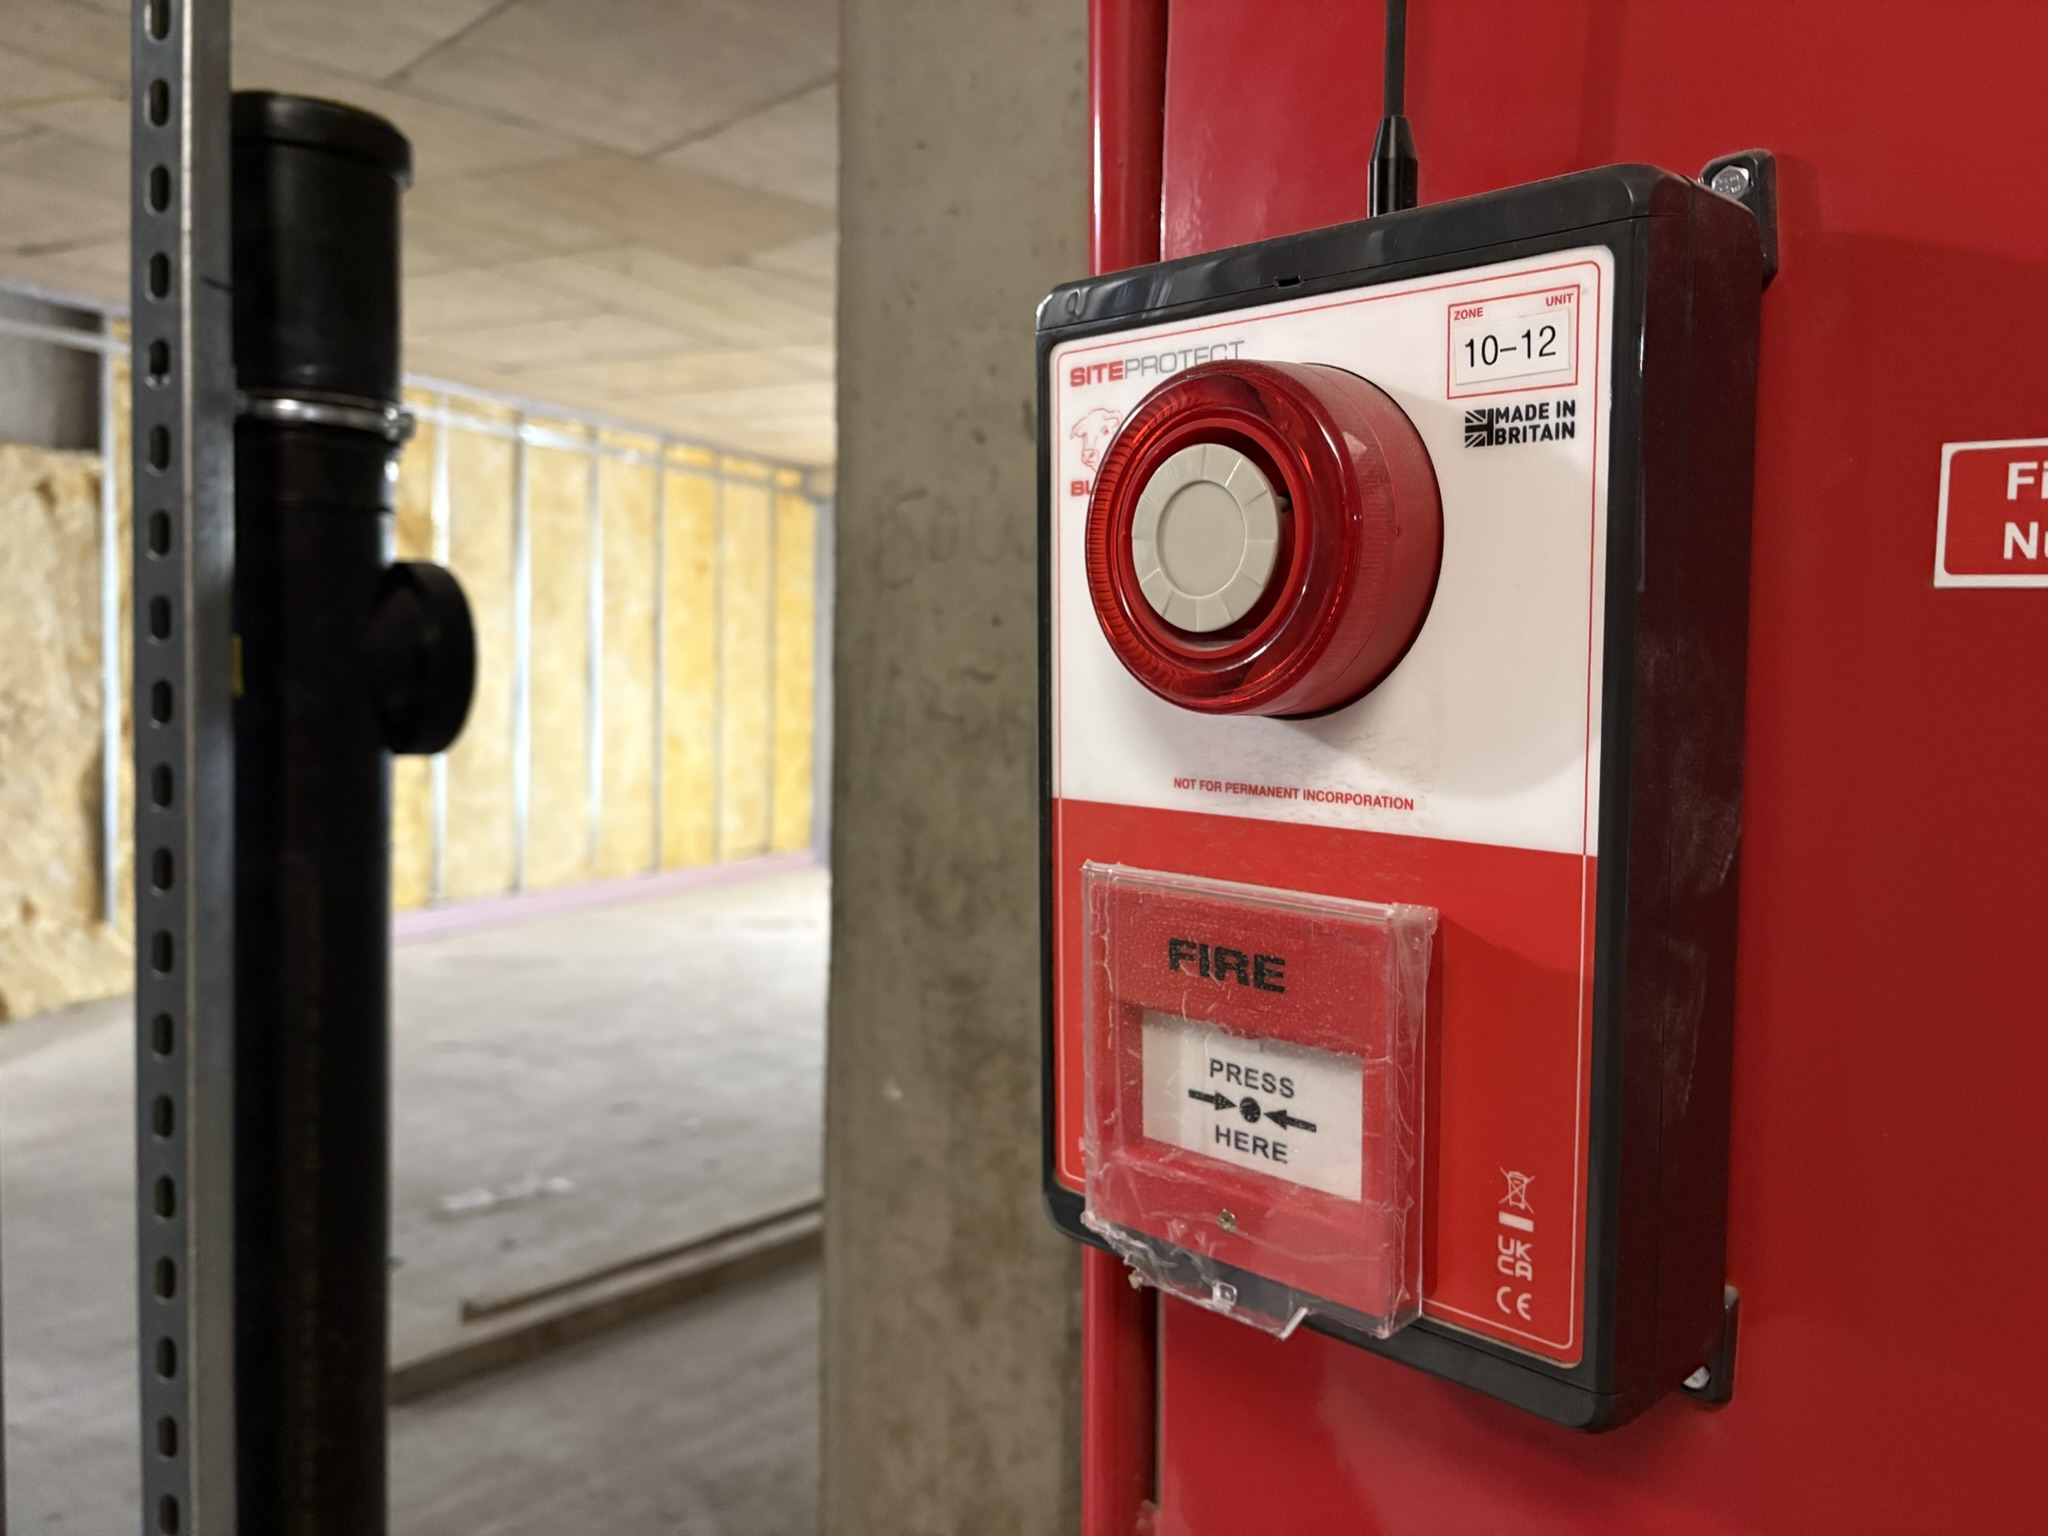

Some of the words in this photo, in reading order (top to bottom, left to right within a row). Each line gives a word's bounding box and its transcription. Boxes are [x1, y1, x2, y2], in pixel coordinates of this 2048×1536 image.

[1454, 307, 1484, 321] ZONE
[1545, 293, 1574, 307] UNIT
[1464, 325, 1557, 368] 10-12
[1495, 402, 1550, 425] MADE
[1556, 400, 1576, 419] IN
[1495, 421, 1576, 446] BRITAIN
[1173, 777, 1197, 790] NOT
[1199, 780, 1223, 793] FOR
[1225, 782, 1300, 800] PERMANENT
[1302, 789, 1415, 811] INCORPORATION
[1168, 937, 1286, 993] FIRE
[1209, 1057, 1295, 1099] PRESS
[1215, 1124, 1288, 1165] HERE
